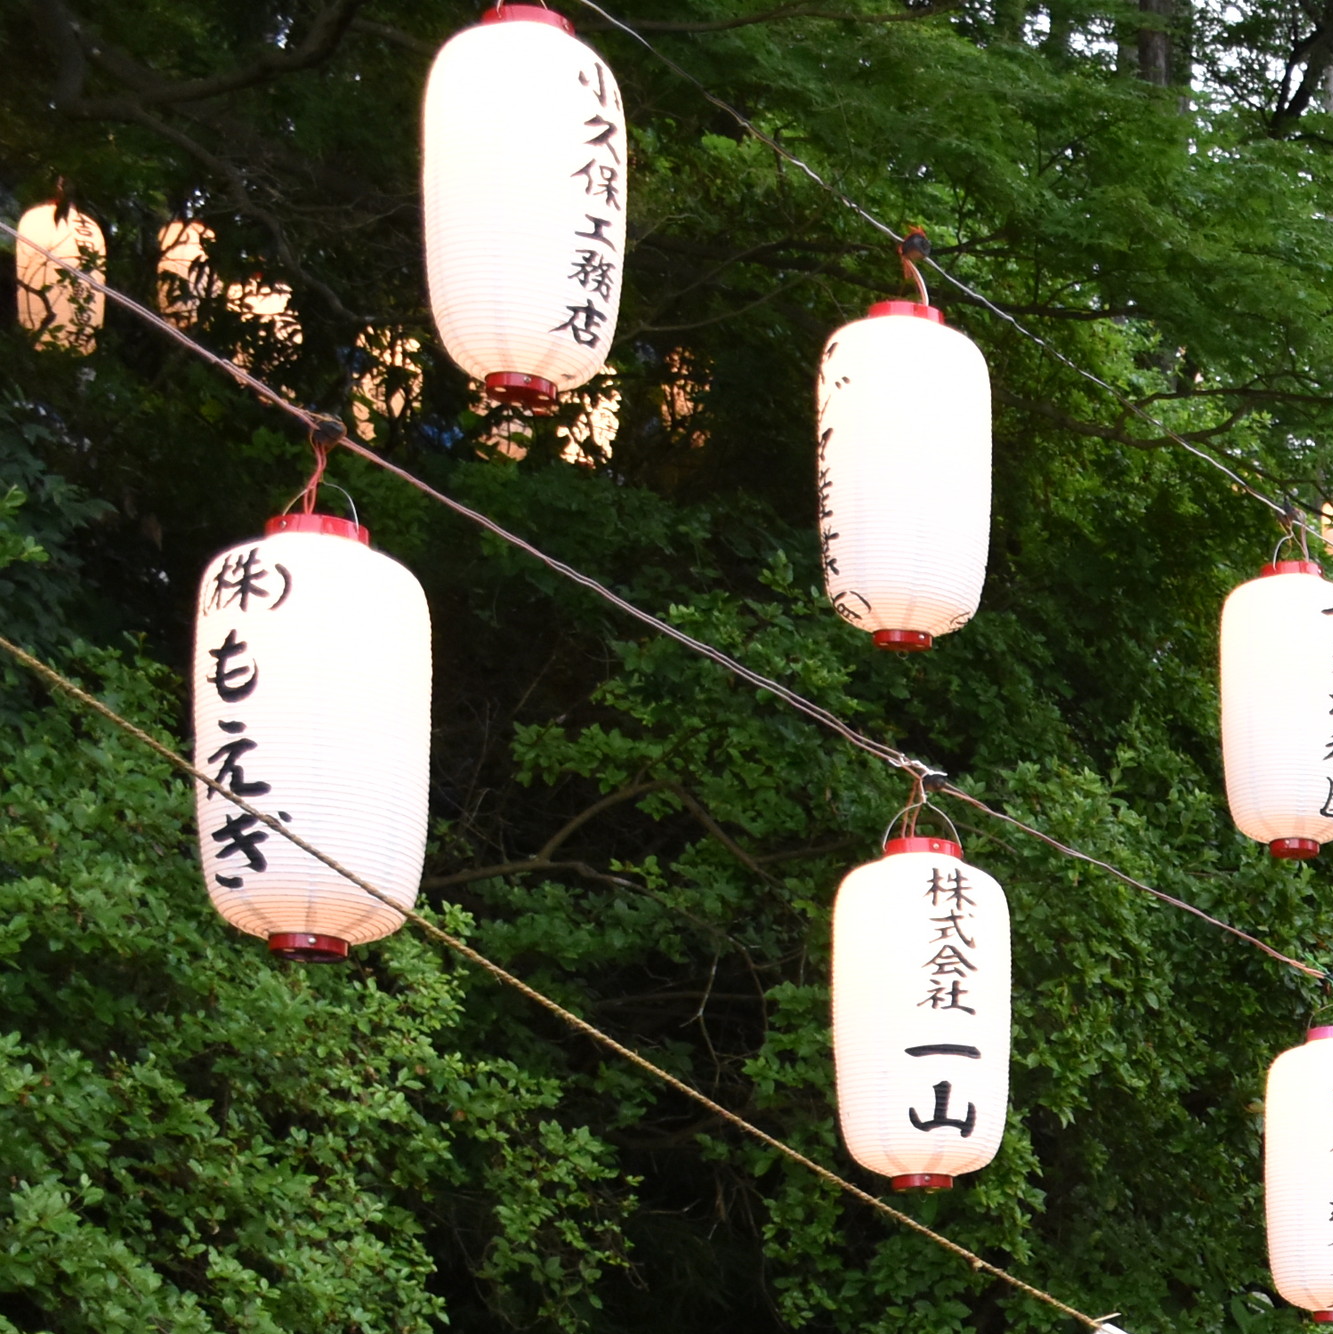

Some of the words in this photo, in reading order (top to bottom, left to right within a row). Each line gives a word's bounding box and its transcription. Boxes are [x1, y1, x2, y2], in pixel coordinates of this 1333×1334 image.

[548, 62, 621, 349] 小久保工務店
